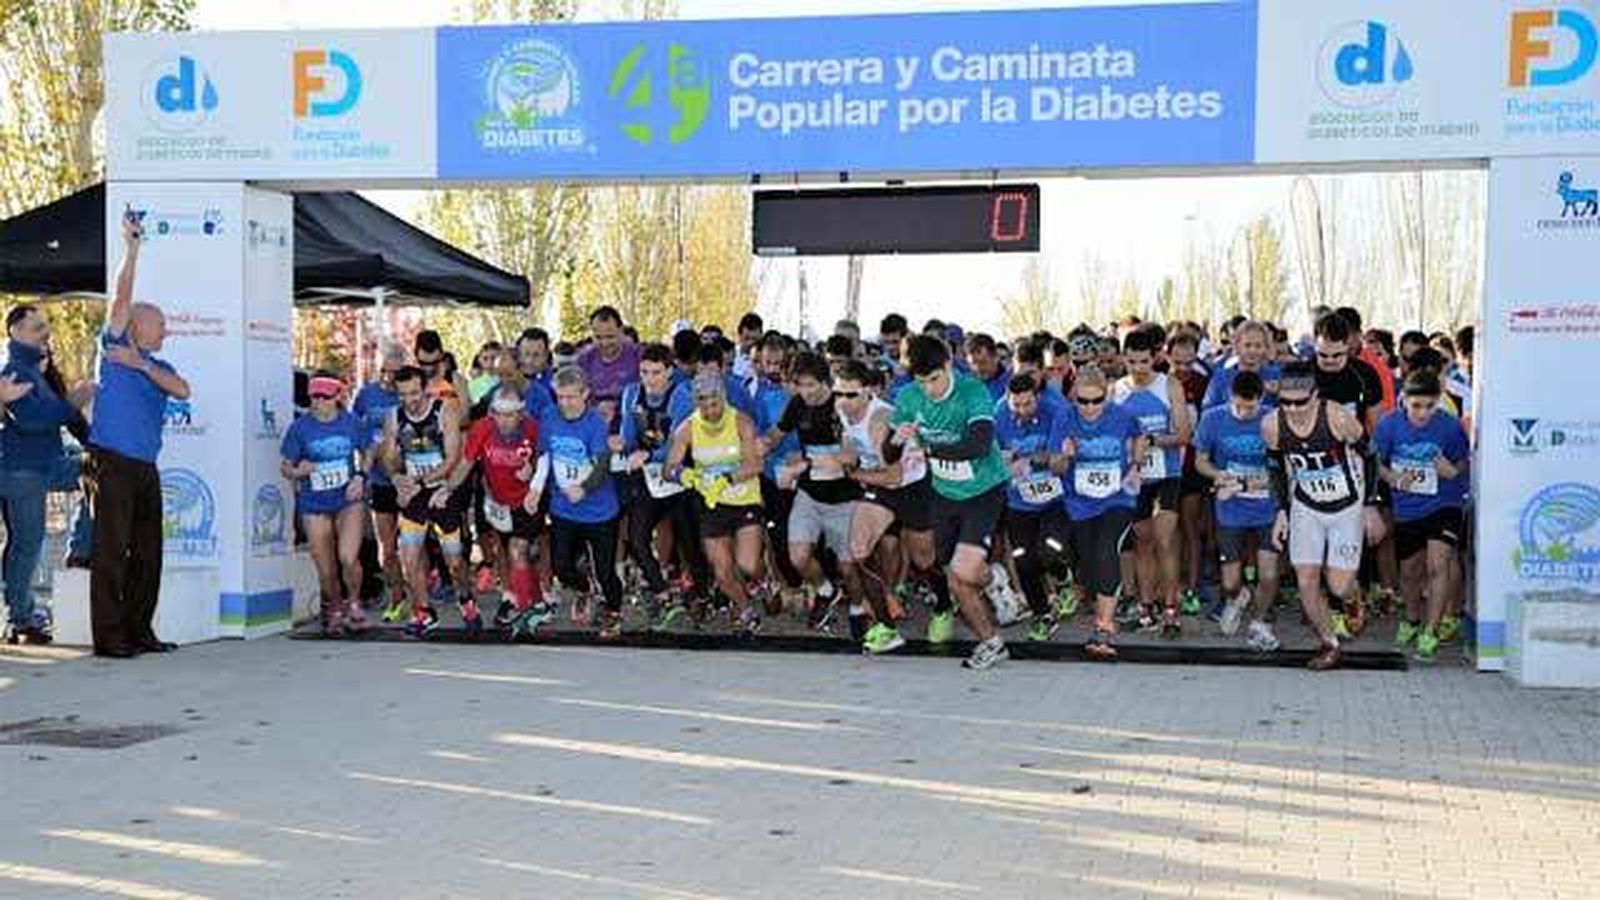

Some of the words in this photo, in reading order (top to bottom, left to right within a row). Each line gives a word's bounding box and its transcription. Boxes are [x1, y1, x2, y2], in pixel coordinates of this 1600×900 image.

[729, 52, 883, 88] Carrera
[895, 56, 920, 90] y
[931, 42, 1135, 82] Caminata
[728, 92, 888, 135] Popular
[899, 97, 969, 132] por
[981, 88, 1017, 122] la
[1031, 84, 1223, 122] Diabetes
[482, 127, 584, 148] DIABETES
[993, 192, 1027, 241] 0
